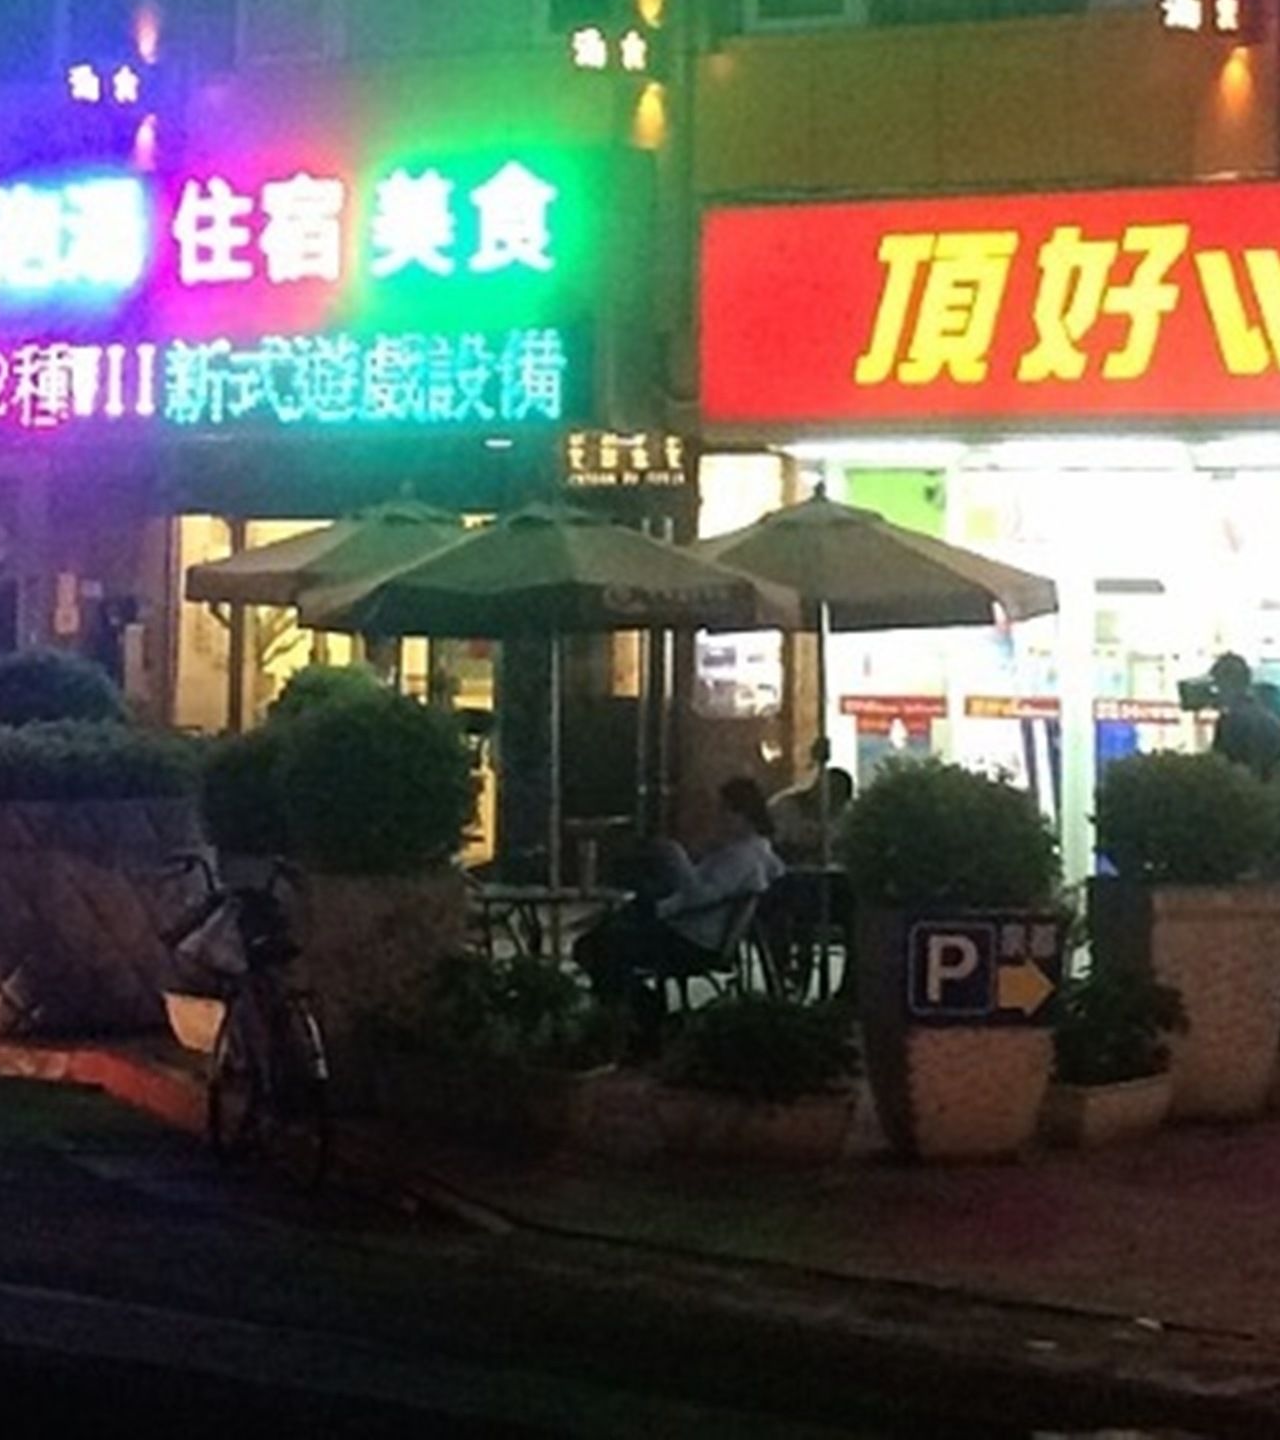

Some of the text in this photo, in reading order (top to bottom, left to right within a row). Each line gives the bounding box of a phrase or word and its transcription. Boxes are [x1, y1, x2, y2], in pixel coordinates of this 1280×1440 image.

[172, 172, 344, 286] 住宿
[372, 162, 558, 275] 美食
[853, 223, 1191, 385] 頂好
[926, 933, 979, 1003] P
